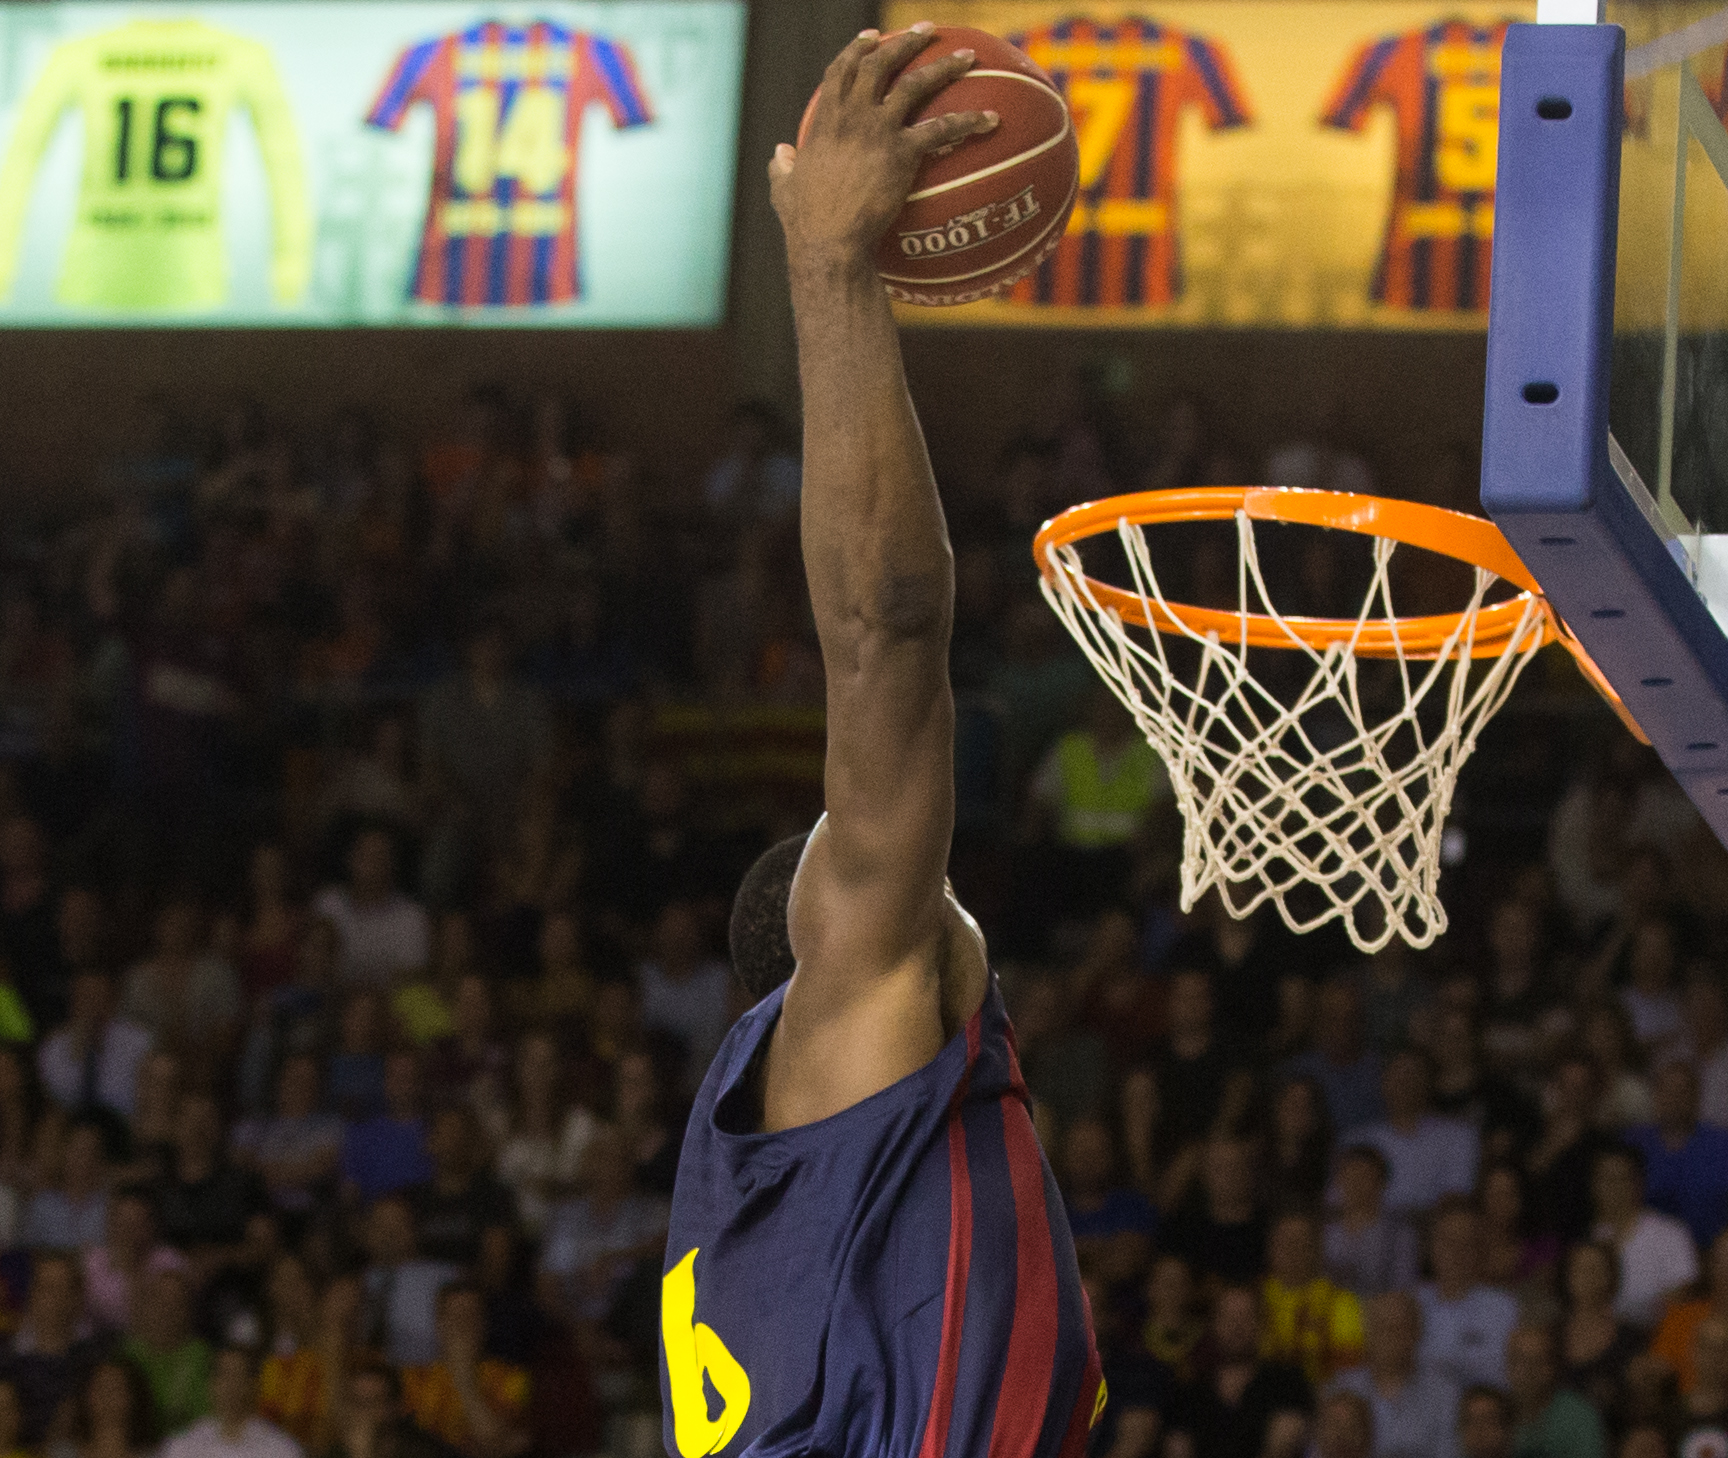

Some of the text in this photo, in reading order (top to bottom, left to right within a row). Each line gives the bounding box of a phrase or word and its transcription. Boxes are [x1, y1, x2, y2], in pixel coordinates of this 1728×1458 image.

[115, 97, 200, 186] 16
[453, 88, 568, 192] 14
[1067, 78, 1136, 190] 7
